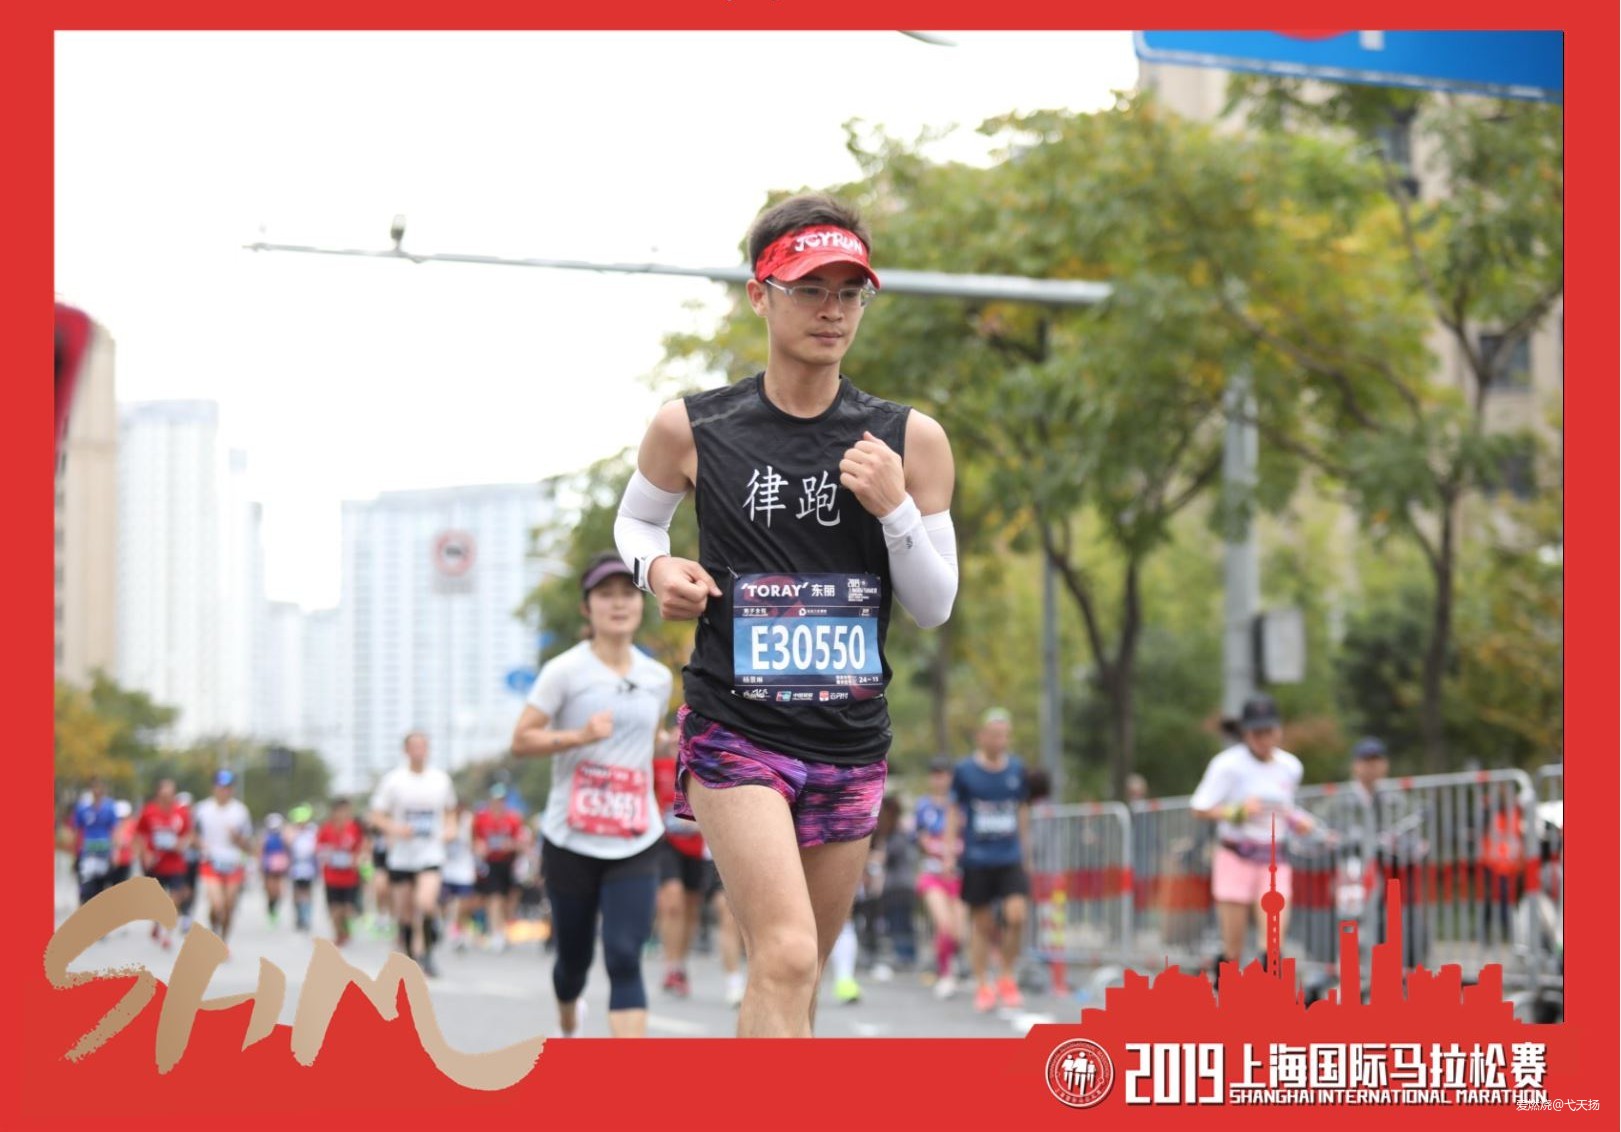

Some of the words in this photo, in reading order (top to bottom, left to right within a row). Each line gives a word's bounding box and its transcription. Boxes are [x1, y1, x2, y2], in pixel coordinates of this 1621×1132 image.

[794, 231, 863, 253] JOYRUN
[742, 465, 841, 529] 律跑
[811, 584, 836, 597] 东丽
[751, 624, 866, 670] E30550
